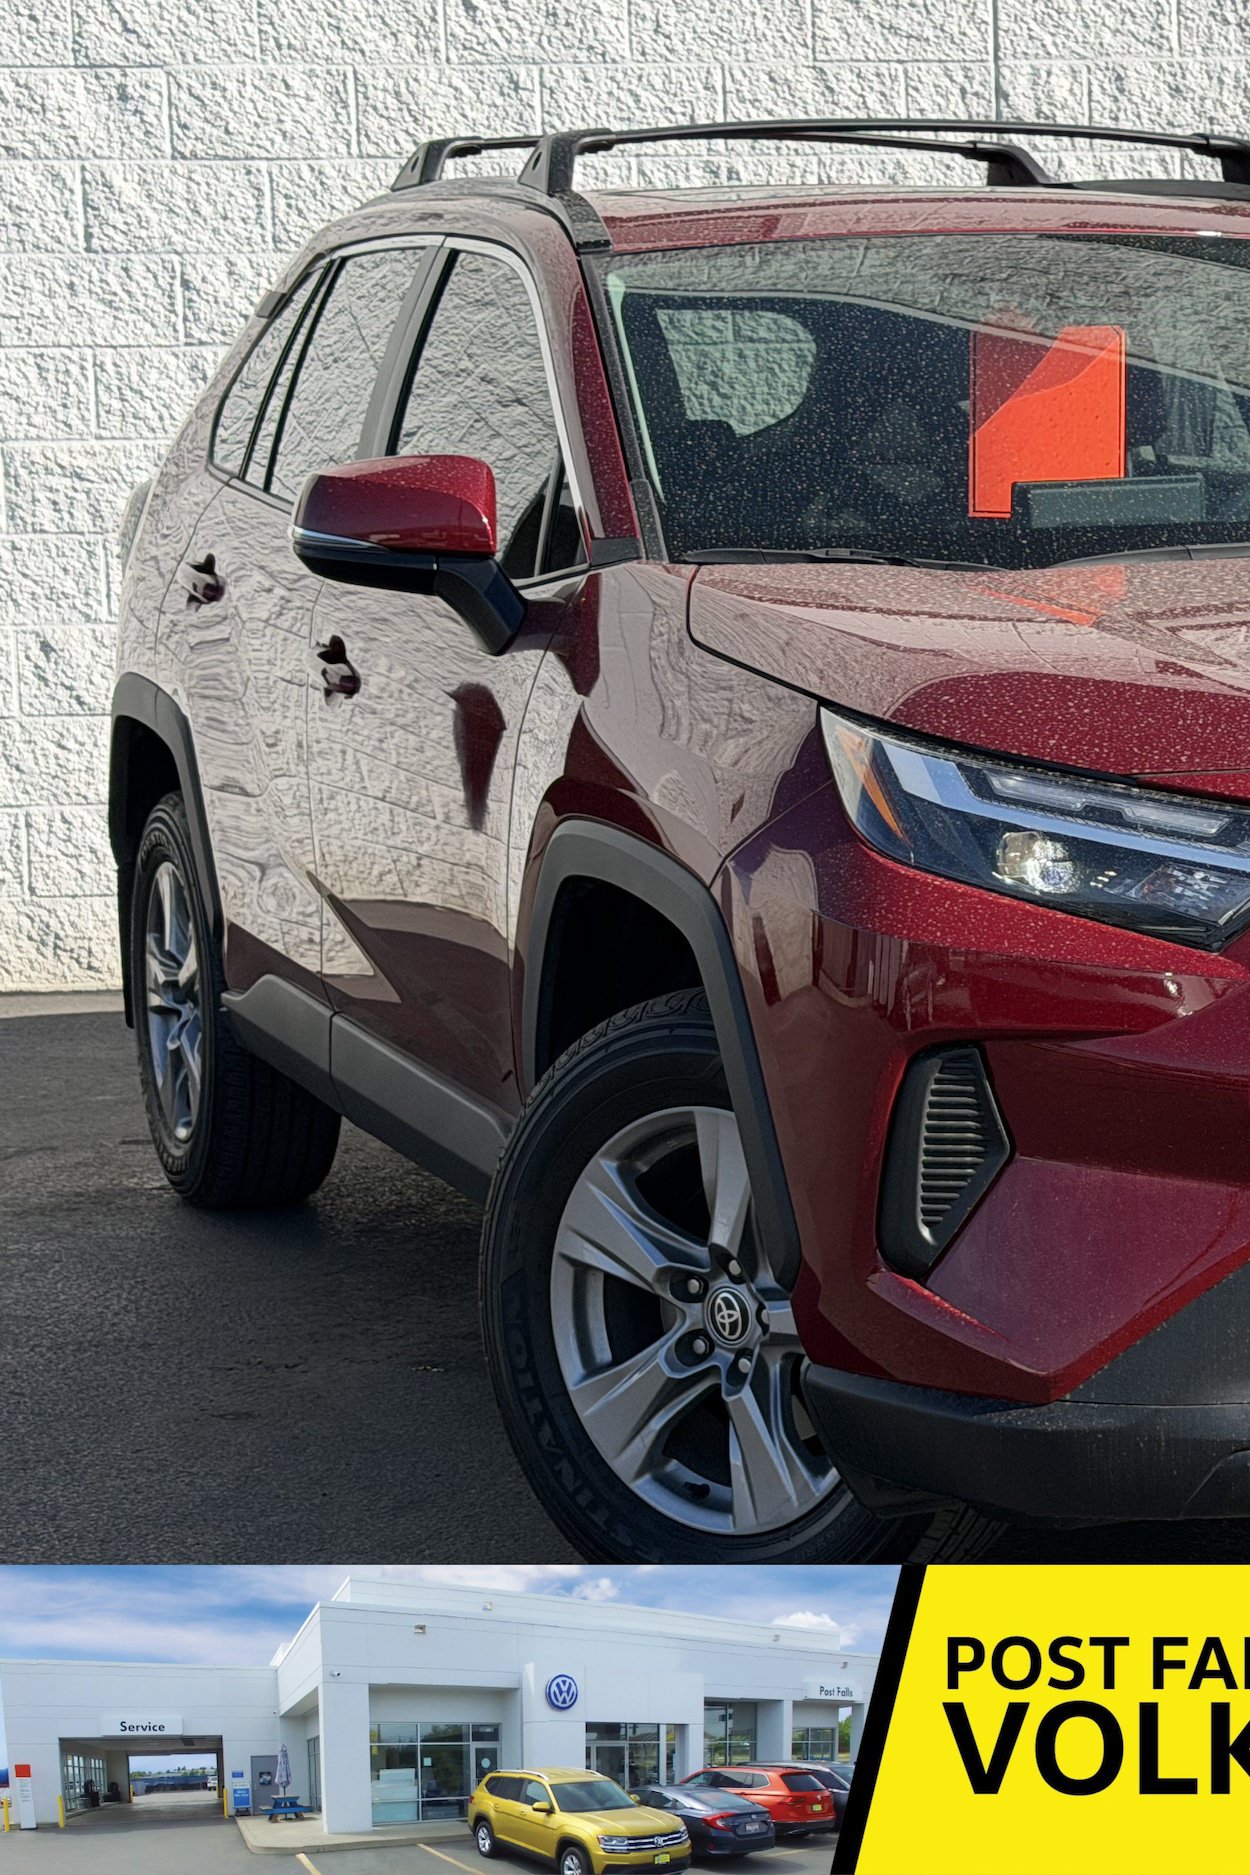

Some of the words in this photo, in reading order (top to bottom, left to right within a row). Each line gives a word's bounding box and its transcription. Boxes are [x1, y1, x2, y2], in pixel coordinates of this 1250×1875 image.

[819, 1685, 835, 1696] Post
[836, 1686, 853, 1697] Falls
[119, 1720, 165, 1733] Service
